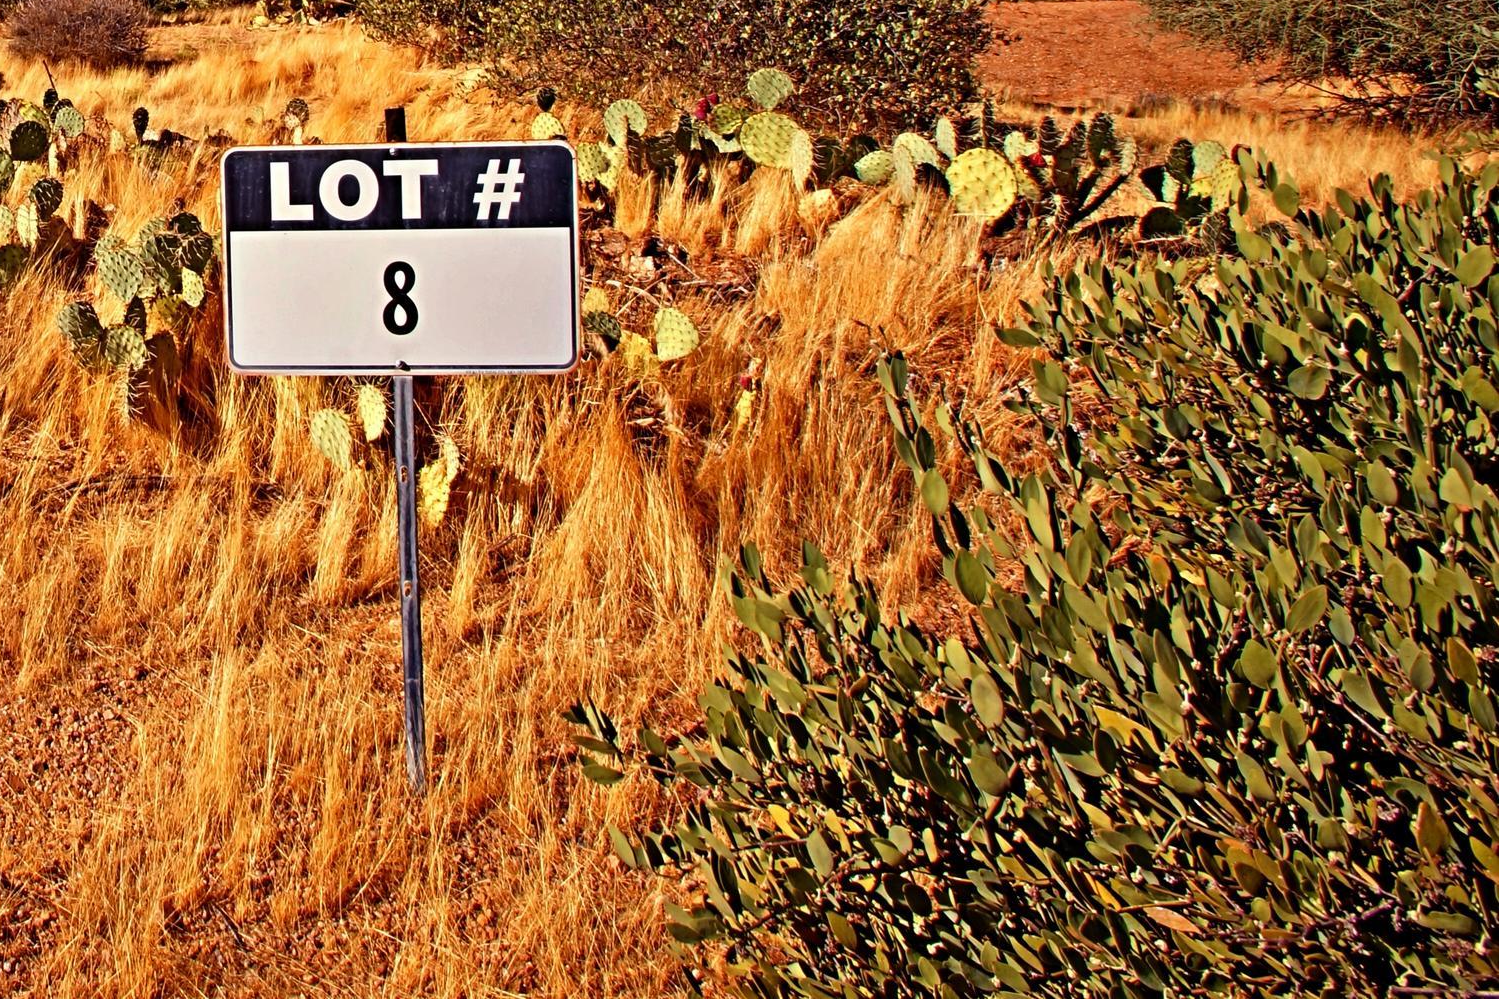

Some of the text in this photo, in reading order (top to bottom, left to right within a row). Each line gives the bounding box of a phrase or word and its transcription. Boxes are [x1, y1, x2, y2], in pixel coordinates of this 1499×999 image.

[269, 158, 526, 221] LOT #
[382, 260, 419, 336] 8
